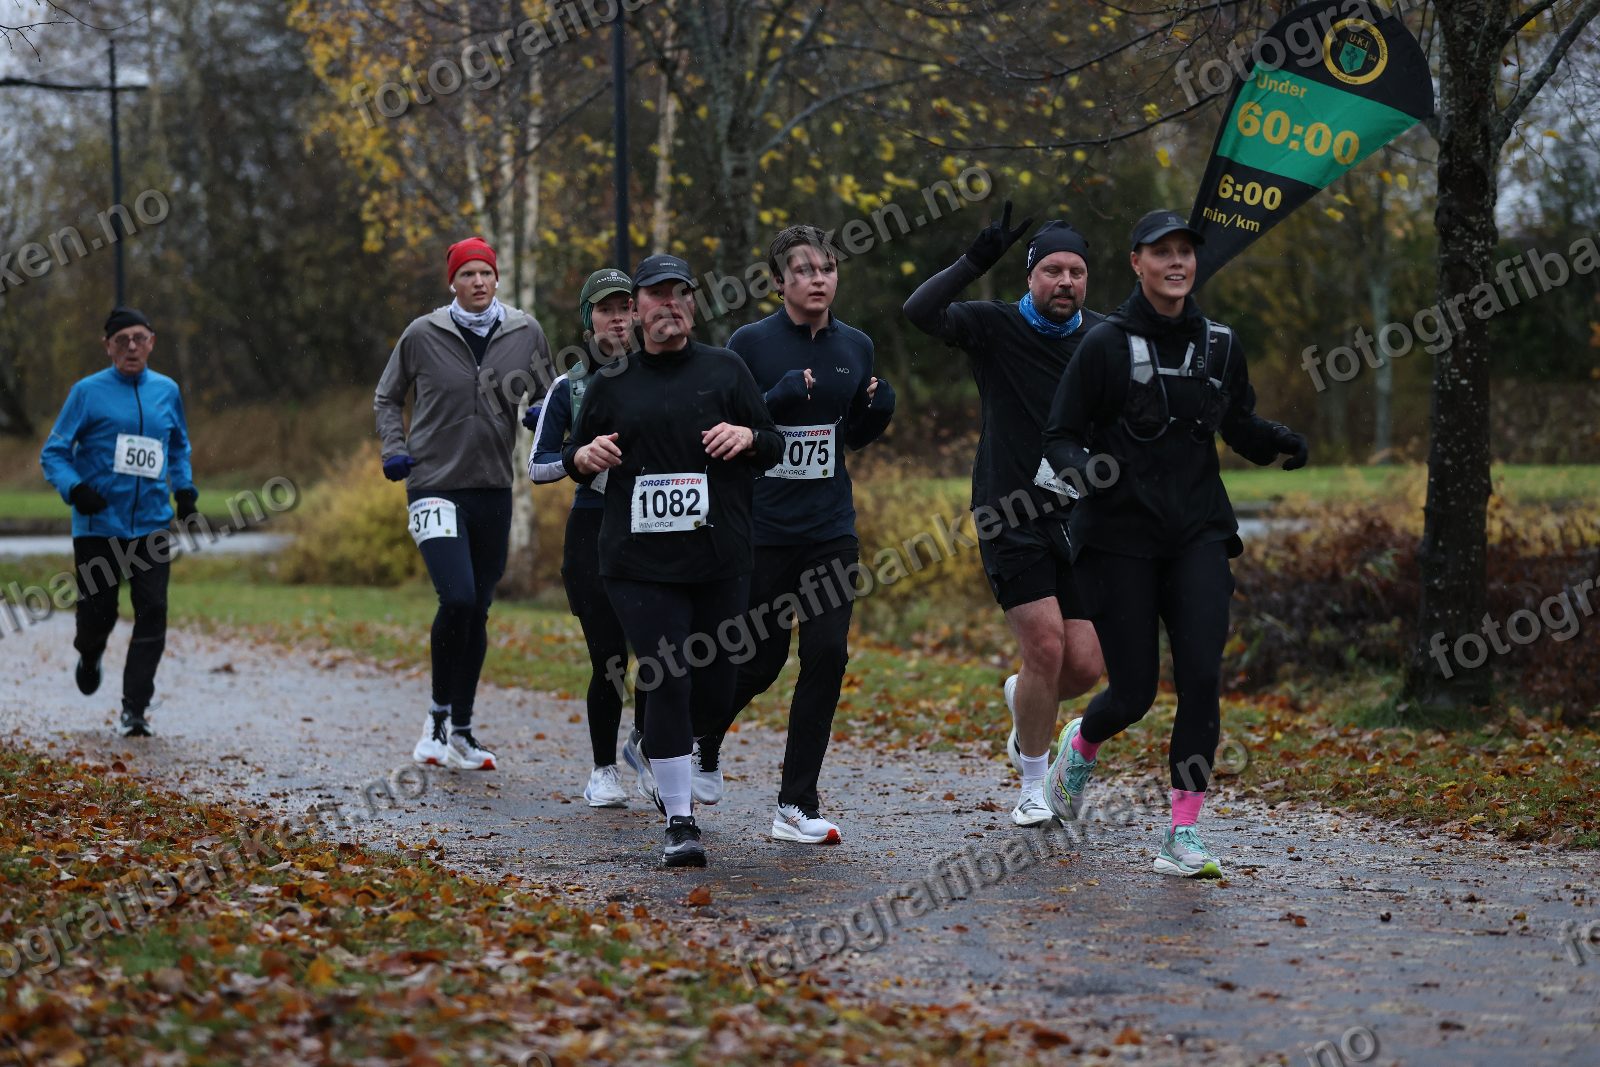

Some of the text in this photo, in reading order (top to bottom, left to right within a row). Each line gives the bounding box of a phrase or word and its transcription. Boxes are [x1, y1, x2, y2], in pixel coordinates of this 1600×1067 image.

[1256, 72, 1307, 97] Under
[1237, 101, 1360, 165] 60:00
[1218, 173, 1282, 211] 6:00
[1202, 206, 1260, 233] min/km
[779, 429, 832, 438] ORGESTESTEN
[125, 447, 156, 469] 506
[638, 488, 701, 519] 1082
[413, 507, 442, 533] 371
